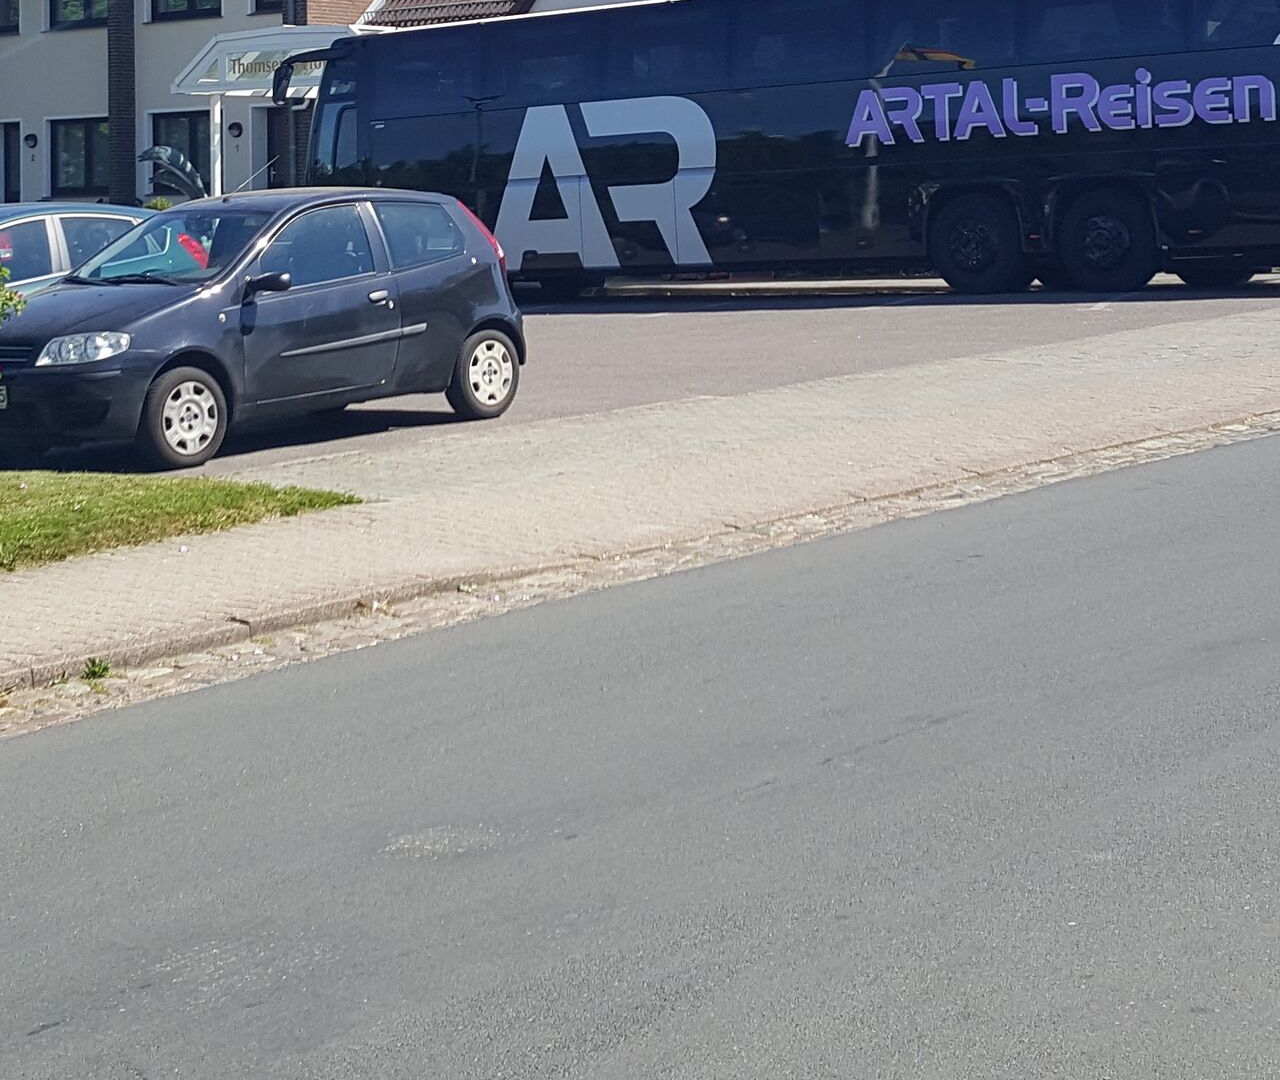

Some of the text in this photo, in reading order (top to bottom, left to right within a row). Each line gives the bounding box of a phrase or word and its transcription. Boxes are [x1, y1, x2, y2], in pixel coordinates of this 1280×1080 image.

[230, 58, 279, 75] Thomse
[845, 67, 1276, 148] ARTAL-Reisen
[493, 95, 717, 270] AR
